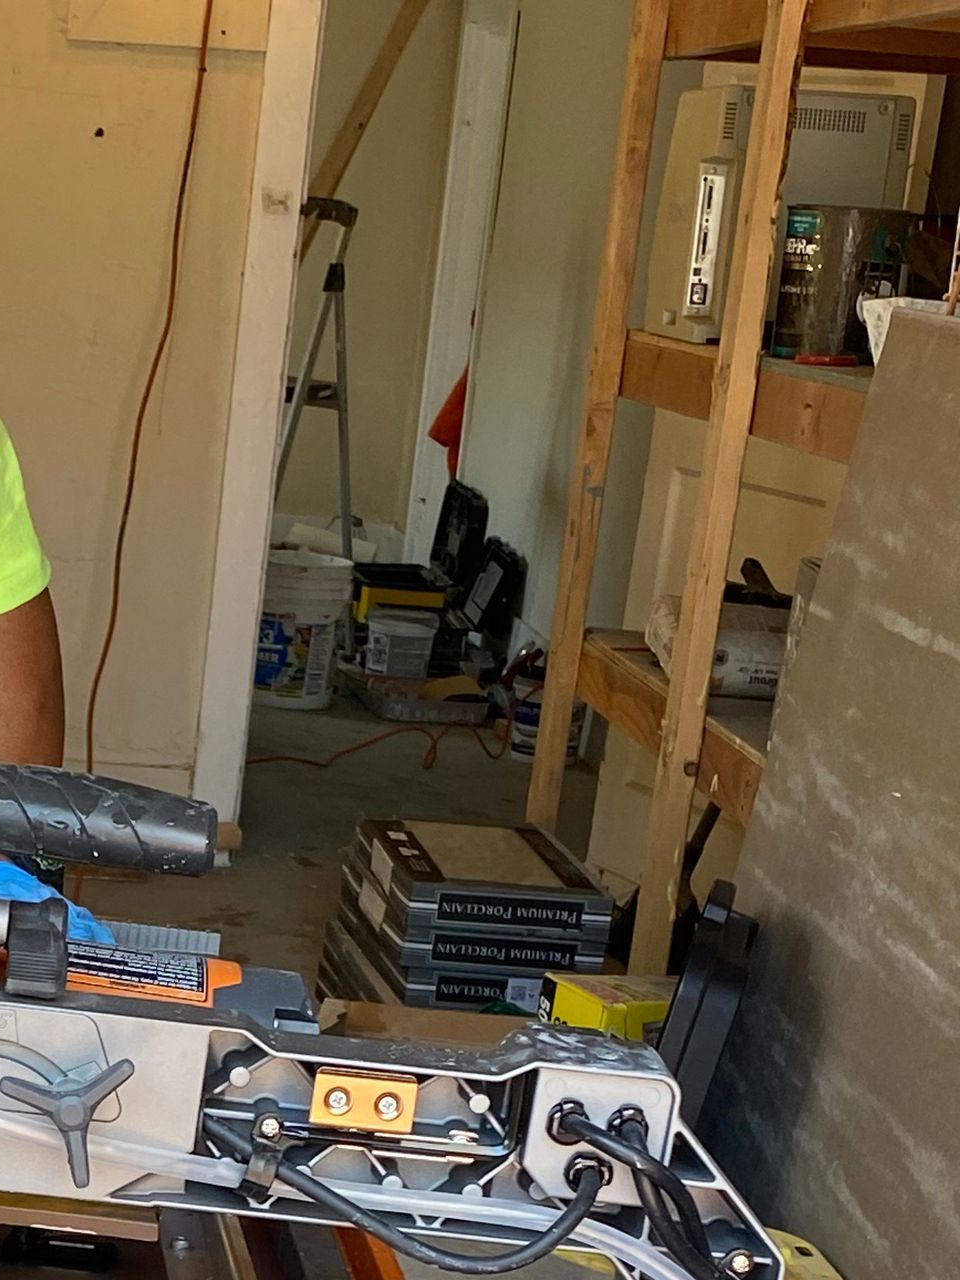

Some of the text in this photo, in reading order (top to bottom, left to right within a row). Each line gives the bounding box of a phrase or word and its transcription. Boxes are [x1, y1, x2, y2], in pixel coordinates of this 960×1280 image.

[442, 901, 577, 924] PREMIUM PORCELAIN
[437, 942, 570, 966] PREMIUM PORCELAIN
